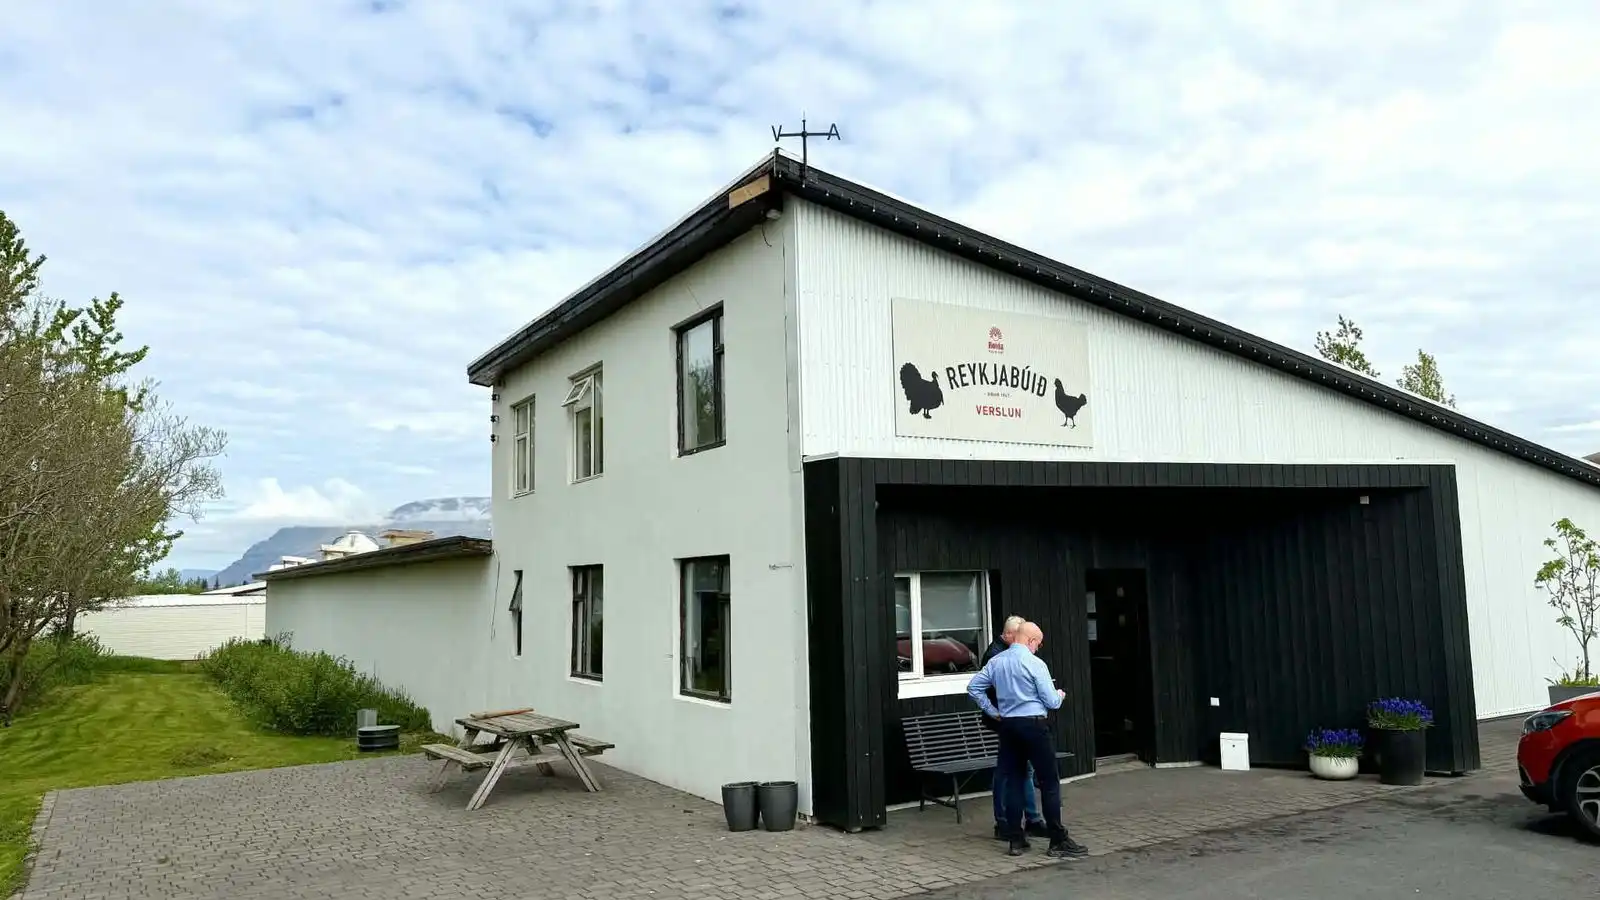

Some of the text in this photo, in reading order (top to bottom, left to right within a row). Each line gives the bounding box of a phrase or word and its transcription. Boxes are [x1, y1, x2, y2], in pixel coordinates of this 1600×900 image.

[771, 124, 782, 142] V
[827, 123, 841, 140] A
[945, 362, 1047, 397] REYKJABÚIÐ
[976, 405, 1021, 418] VERSLUN
